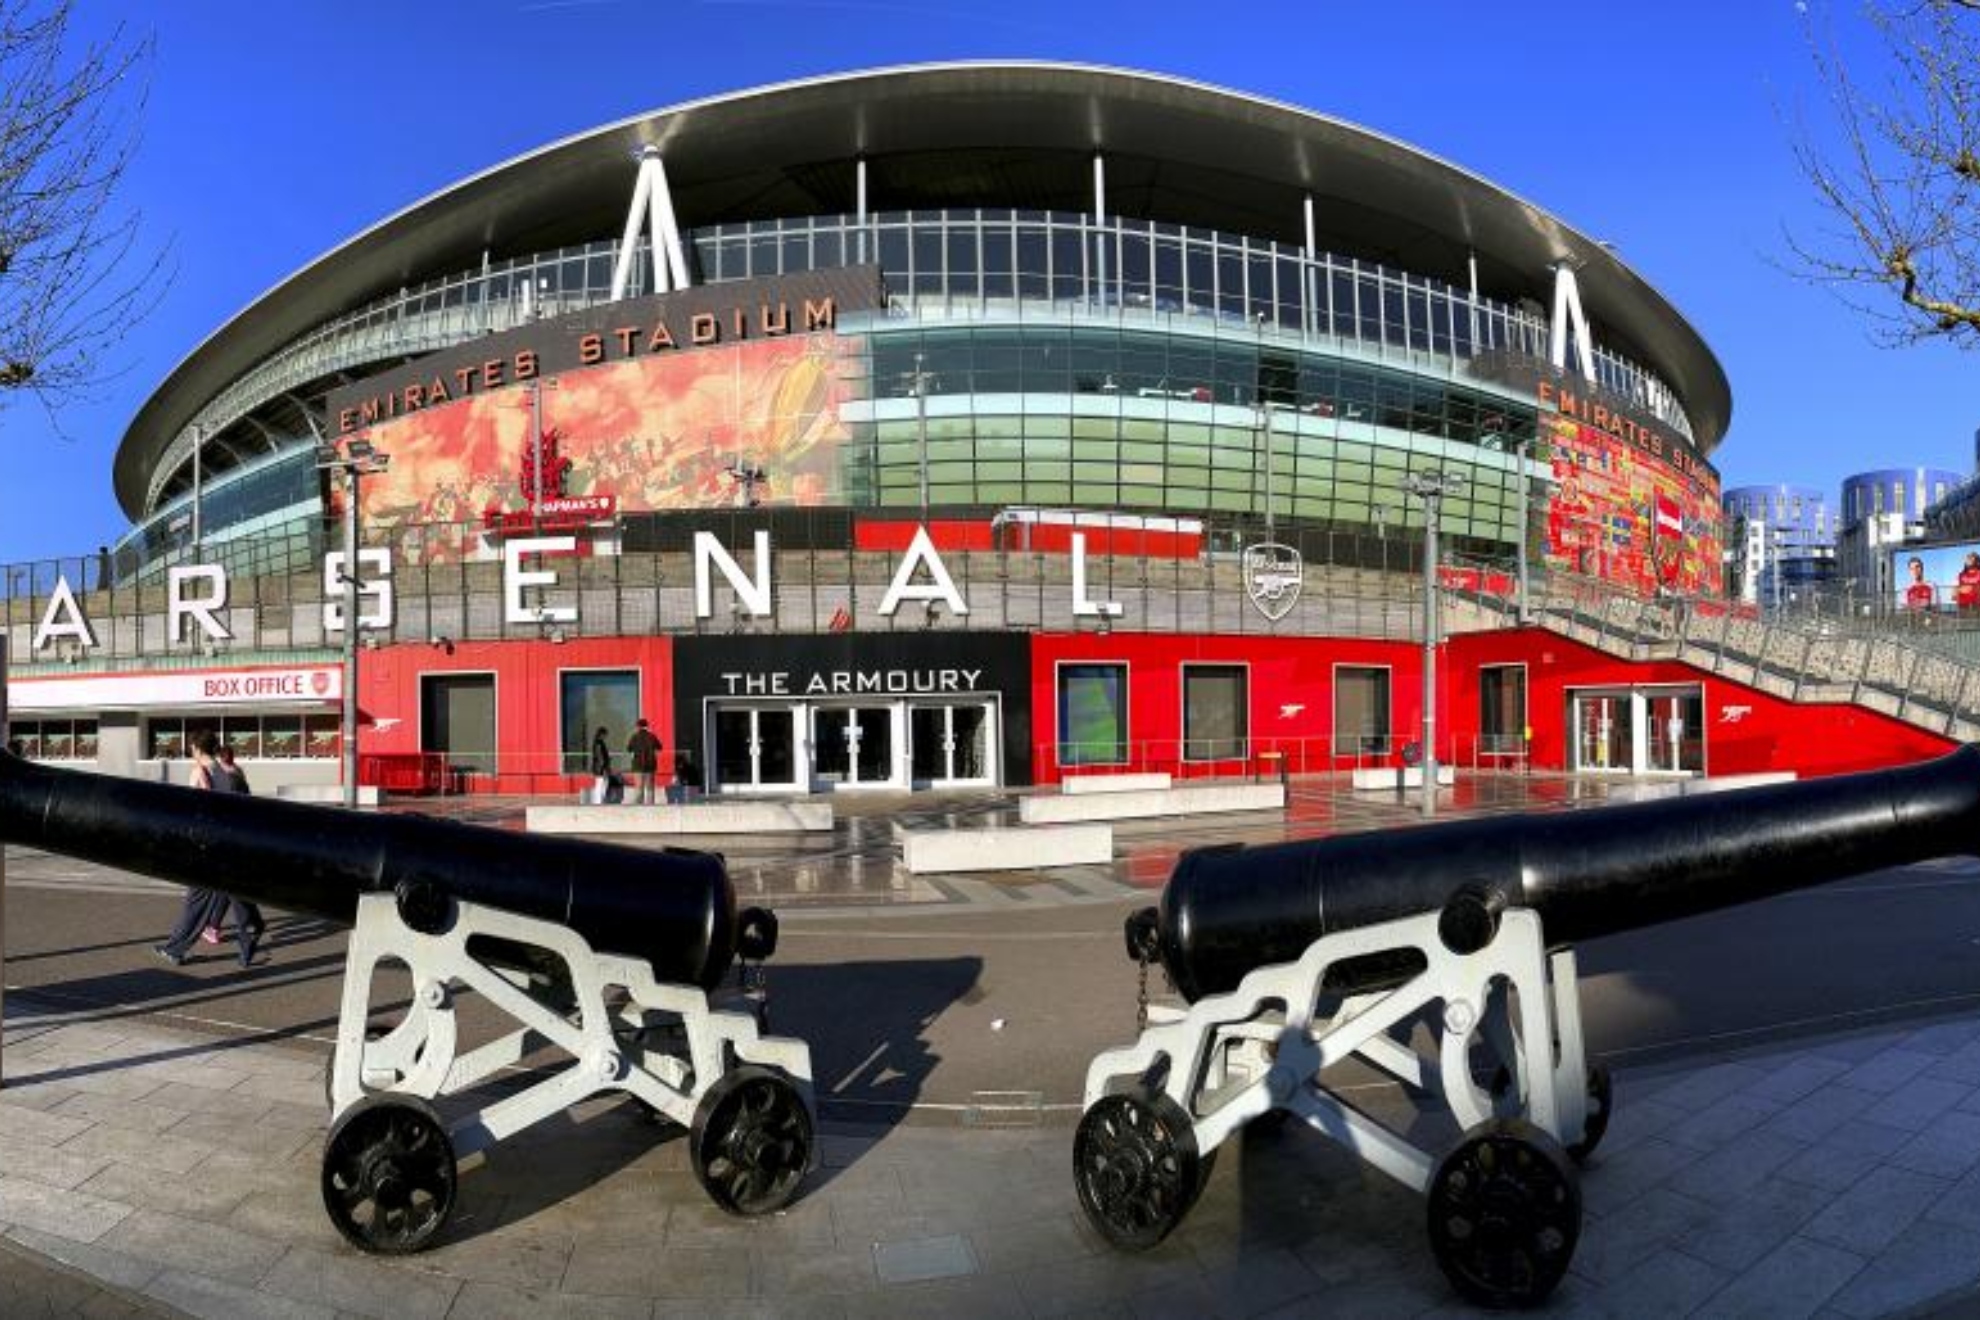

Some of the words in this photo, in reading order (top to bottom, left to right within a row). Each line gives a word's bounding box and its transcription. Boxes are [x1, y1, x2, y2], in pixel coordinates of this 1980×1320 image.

[340, 350, 537, 432] EMIRATES
[579, 297, 836, 363] STADIUM
[1539, 381, 1663, 456] EMIRATES
[33, 524, 1124, 648] ARSENAL
[204, 677, 241, 697] BOX
[245, 675, 303, 695] OFFICE
[721, 672, 789, 695] THE
[806, 669, 981, 693] ARMOURY
